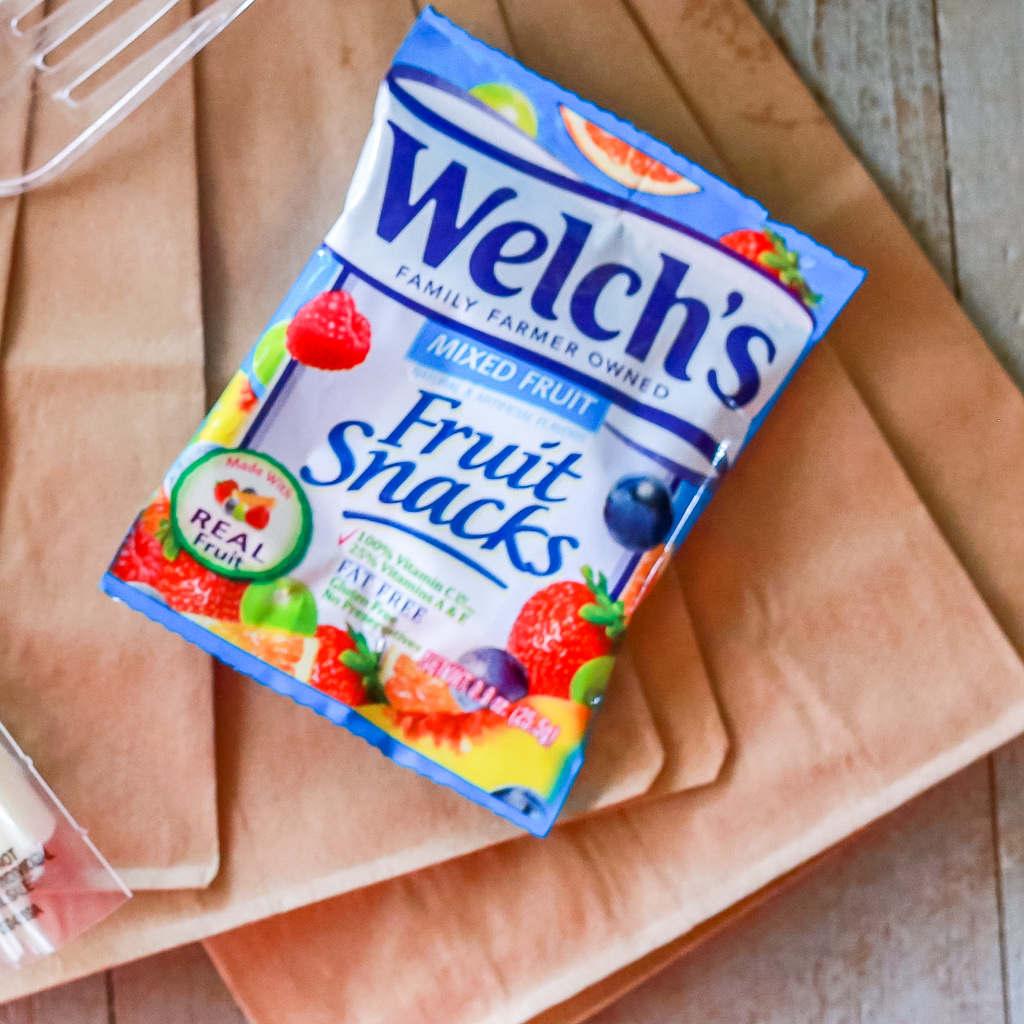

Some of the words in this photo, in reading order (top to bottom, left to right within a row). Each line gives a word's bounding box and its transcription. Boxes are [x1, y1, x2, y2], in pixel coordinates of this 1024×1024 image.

[376, 120, 777, 410] Welch's
[395, 265, 479, 314] FAMILY
[487, 307, 580, 358] FARMER
[588, 351, 671, 402] OWNED
[426, 332, 518, 383] MIXED
[517, 369, 600, 417] FRUIT
[226, 457, 263, 477] Made
[377, 388, 584, 503] Fruit
[299, 420, 581, 577] Snacks
[190, 508, 264, 564] REAL
[193, 532, 242, 571] Fruit
[357, 531, 394, 560] 100%
[397, 553, 444, 592] Vitamin
[322, 588, 341, 606] No
[329, 576, 370, 606] Gluten
[370, 600, 398, 624] Free
[337, 559, 377, 589] FAT
[377, 581, 429, 624] FREE
[348, 543, 378, 568] 25%
[380, 561, 434, 603] Vitamins
